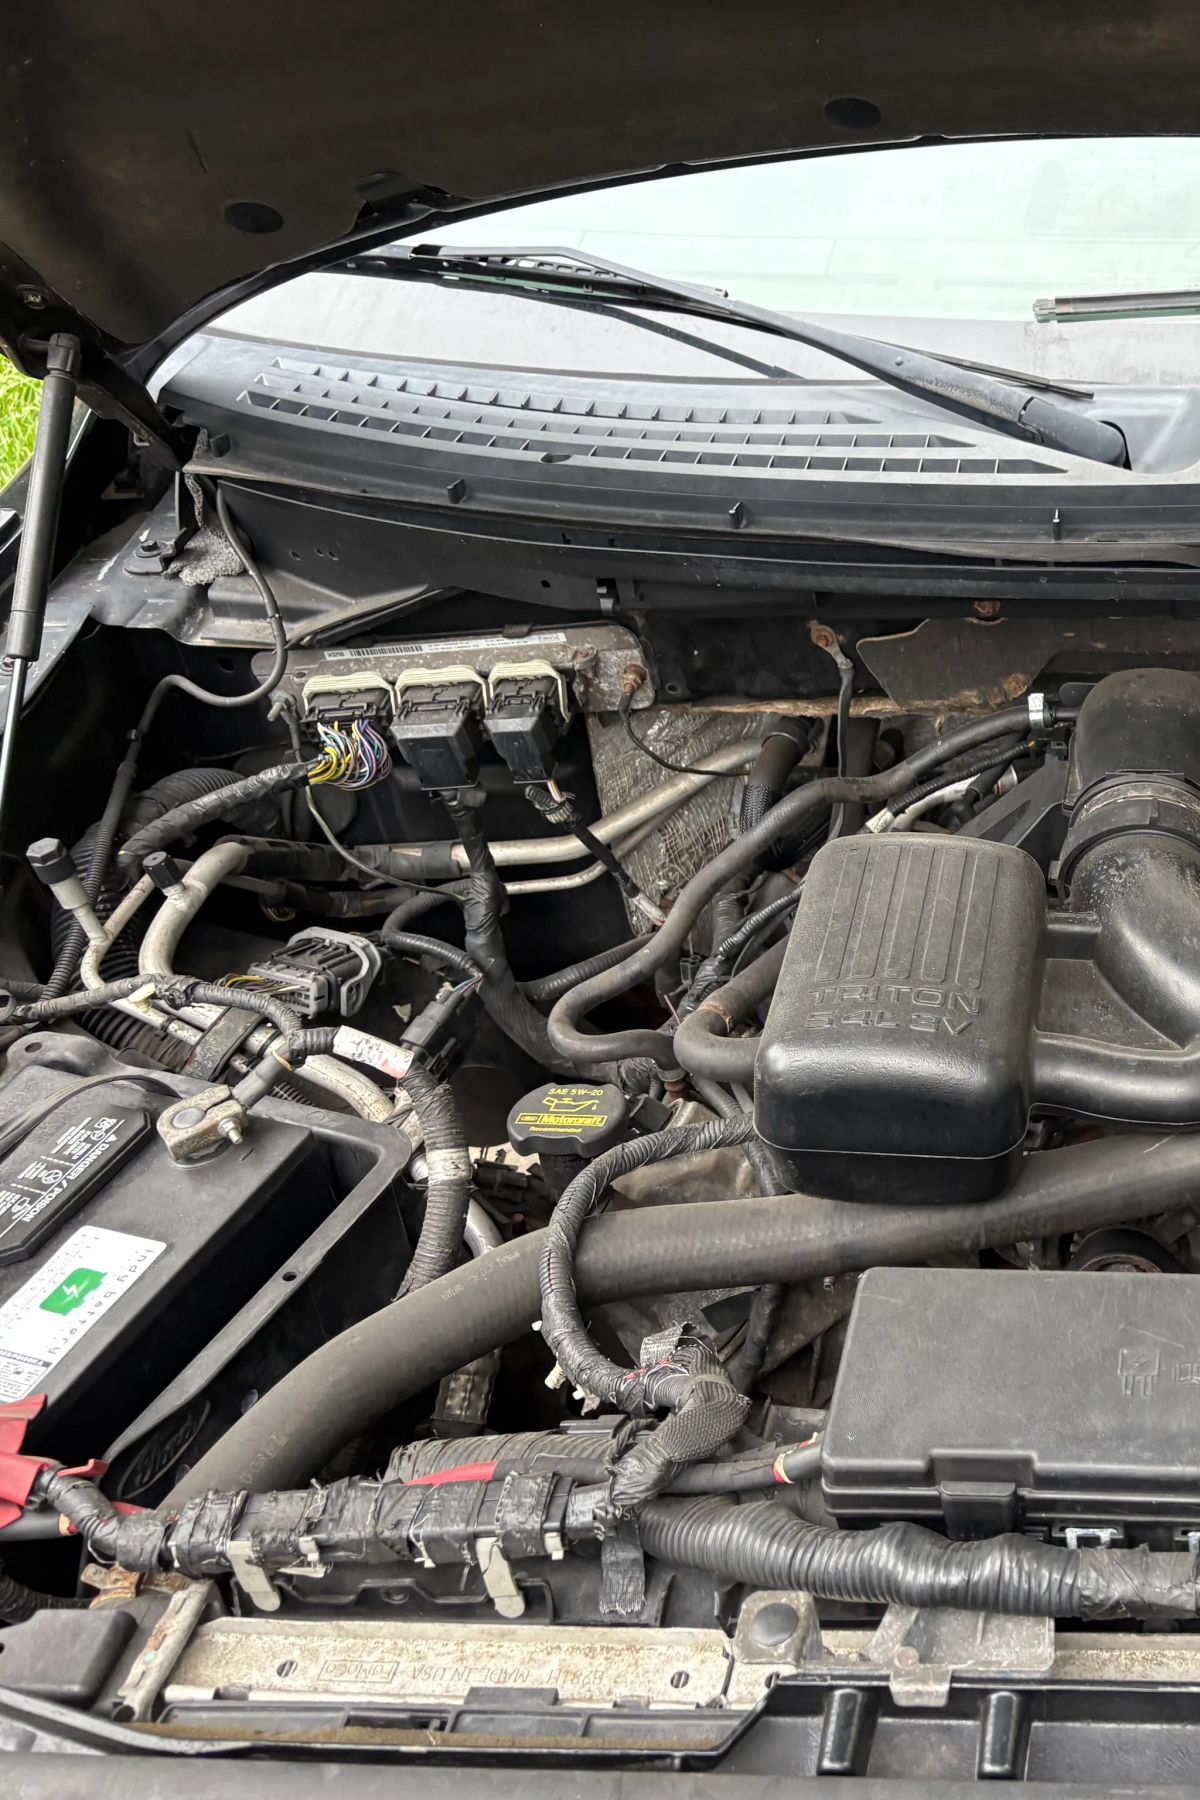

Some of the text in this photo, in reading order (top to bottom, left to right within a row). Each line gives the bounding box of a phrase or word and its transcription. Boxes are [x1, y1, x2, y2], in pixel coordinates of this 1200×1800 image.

[808, 985, 982, 1015] TRITON
[910, 1012, 973, 1036] 3V
[548, 1088, 604, 1096] SAE 5W-20
[541, 1115, 602, 1126] Motorcraft
[67, 1143, 110, 1180] DANGER
[21, 1187, 63, 1222] POISON
[325, 1661, 397, 1681] FoMoCo
